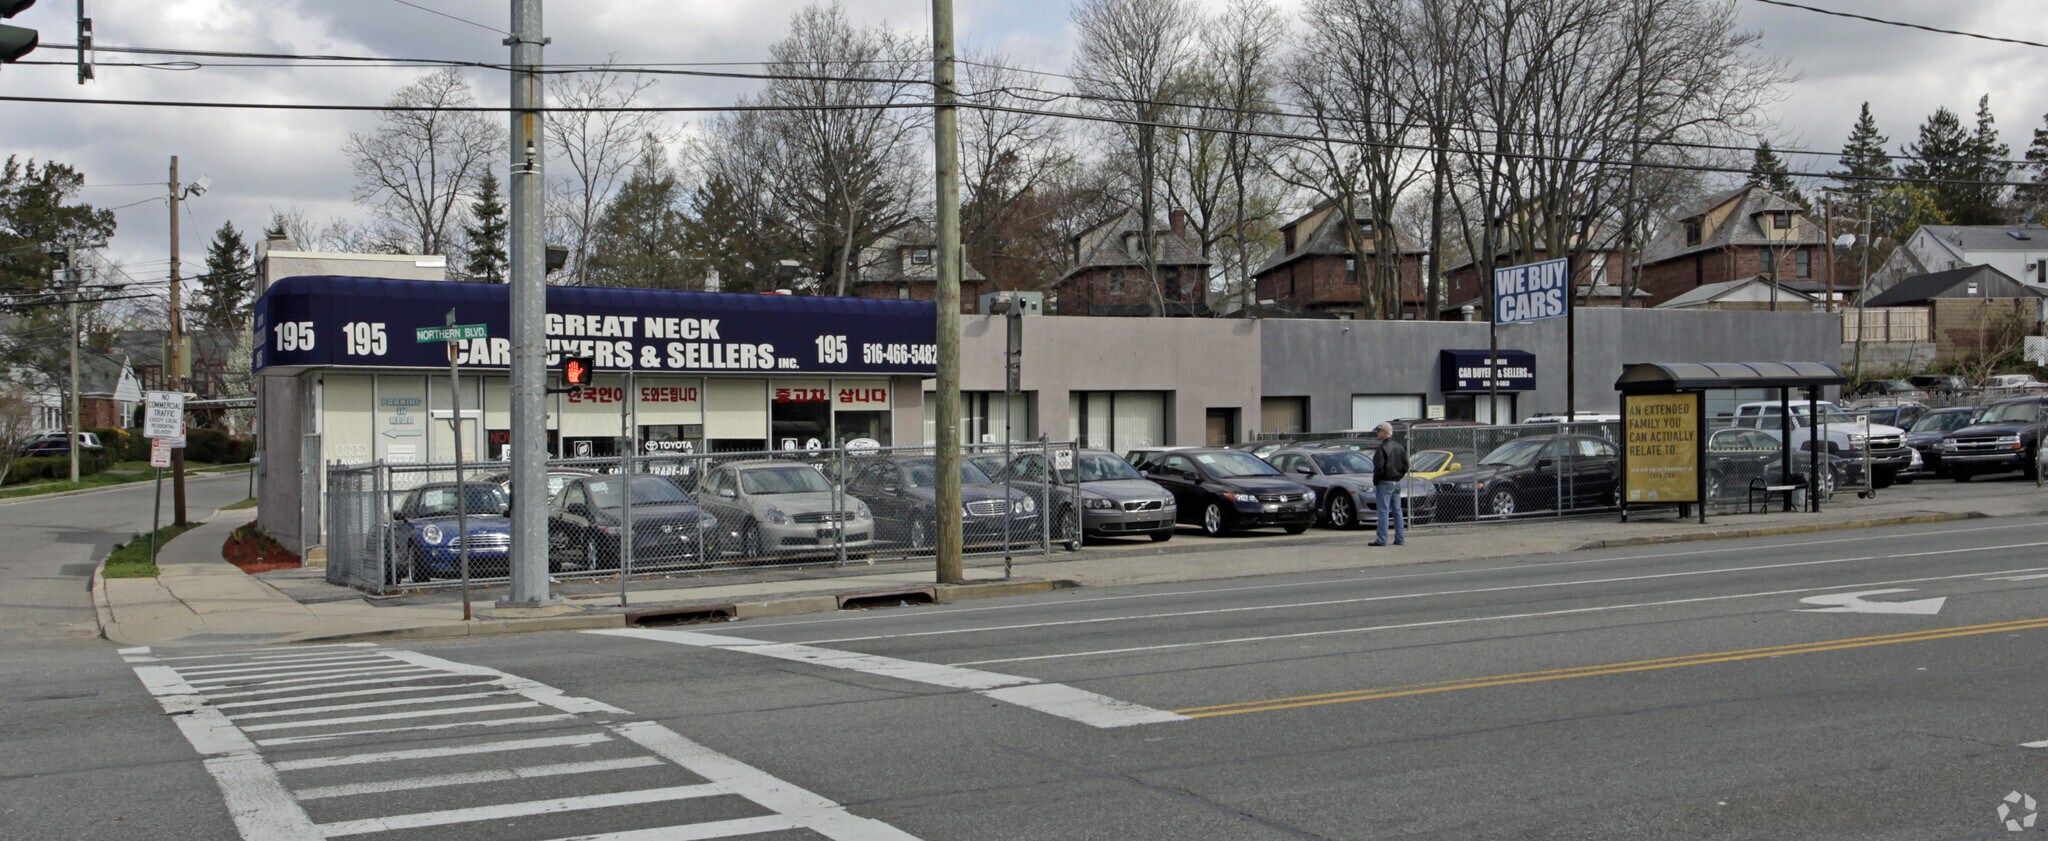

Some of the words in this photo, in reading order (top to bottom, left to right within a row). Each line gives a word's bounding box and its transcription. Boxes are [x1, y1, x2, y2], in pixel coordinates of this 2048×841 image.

[1497, 268, 1525, 295] WE
[1528, 262, 1565, 291] BUY
[1500, 289, 1562, 322] CARS
[546, 313, 638, 338] GREAT
[645, 316, 720, 340] NECK
[274, 321, 315, 351] 195
[343, 322, 388, 356] 195
[417, 329, 461, 341] NORTHERN
[465, 327, 487, 337] BLVD.
[447, 338, 510, 365] CAR
[546, 339, 633, 368] UYERS
[640, 344, 661, 368] &
[667, 342, 775, 369] SELLERS
[778, 357, 800, 369] INC.
[815, 335, 848, 364] 195
[863, 342, 937, 365] 516-466-5482
[1459, 367, 1472, 378] CAR
[1497, 369, 1502, 378] &
[1503, 367, 1528, 378] SELLERS
[641, 387, 697, 402] 도와드립니다
[776, 388, 825, 403] 중고차
[839, 388, 886, 403] 삽니다
[149, 401, 181, 410] COMMERCIAL
[381, 398, 421, 406] PARKING
[396, 407, 407, 415] IN
[1629, 405, 1641, 416] AN
[1645, 404, 1689, 415] EXTENDED
[390, 416, 414, 424] REAR
[1629, 418, 1661, 429] FAMILY
[1664, 418, 1681, 428] YOU
[1629, 432, 1647, 443] CAN
[1651, 430, 1694, 442] ACTUALLY
[658, 441, 692, 449] TOYOTA
[1630, 445, 1661, 456] RELATE
[649, 466, 690, 475] TRADE-IN
